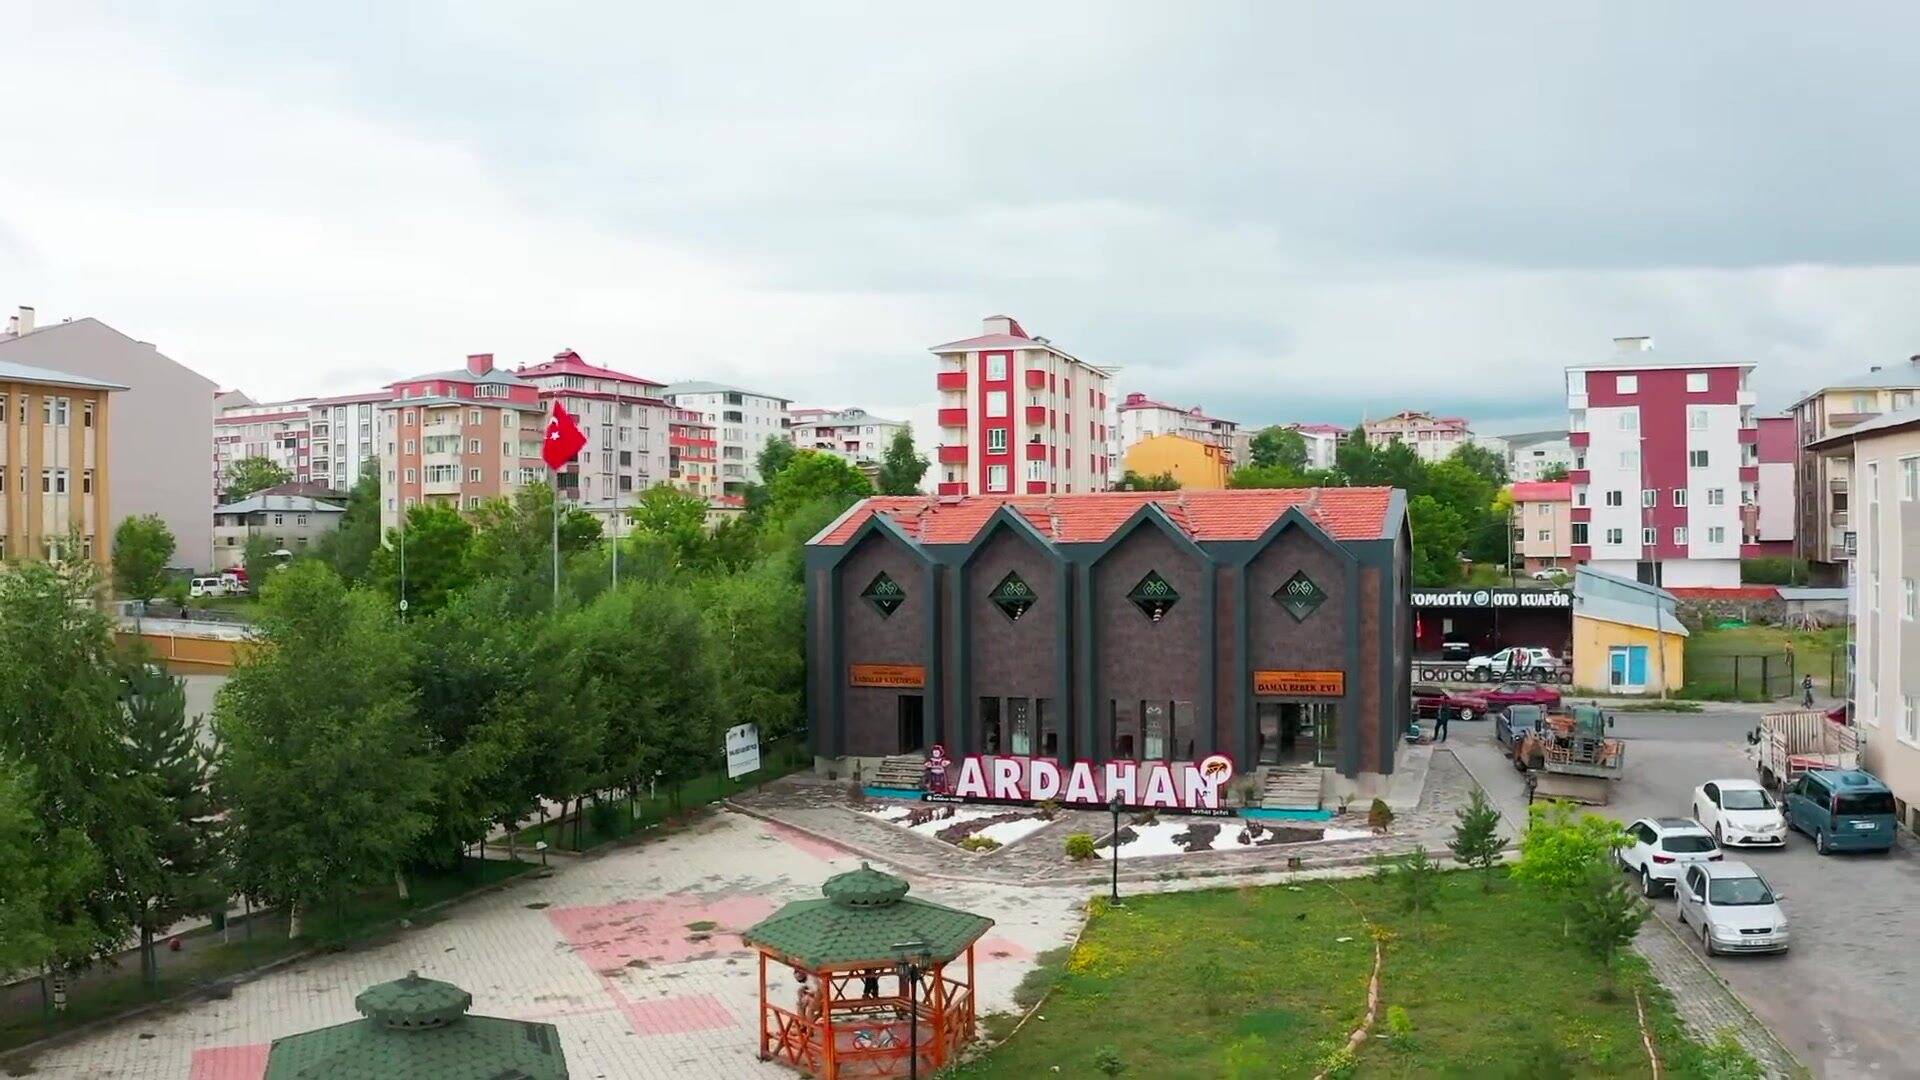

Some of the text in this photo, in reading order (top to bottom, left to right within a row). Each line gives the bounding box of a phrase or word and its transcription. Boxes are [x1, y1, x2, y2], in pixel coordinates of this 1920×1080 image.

[1493, 591, 1570, 606] OTO KUAFÖR
[955, 755, 1220, 809] ARDAHAN
